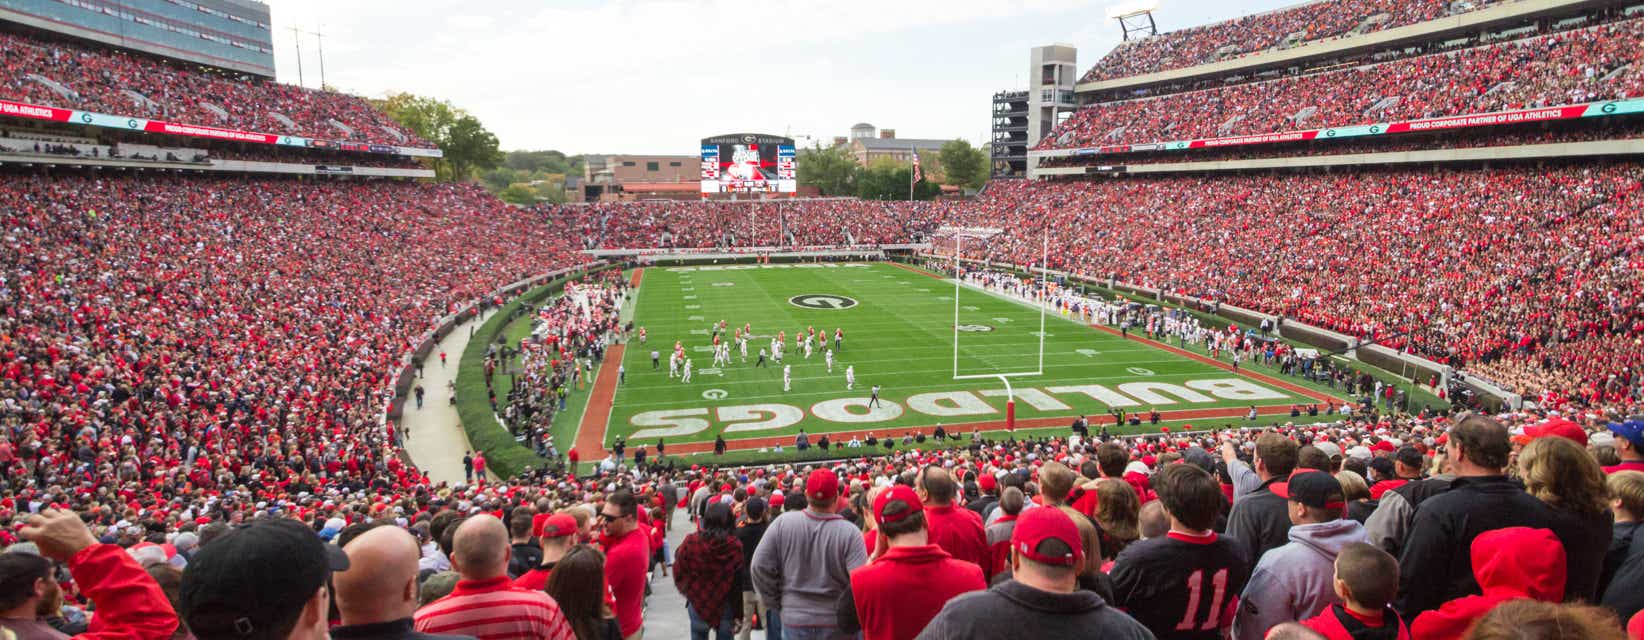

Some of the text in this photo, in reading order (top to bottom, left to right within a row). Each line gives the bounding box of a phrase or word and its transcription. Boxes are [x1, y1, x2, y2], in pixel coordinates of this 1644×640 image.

[3, 103, 18, 113] UGA
[20, 105, 53, 118] ATHLETICS
[1601, 103, 1616, 114] G
[82, 113, 93, 123] G
[1409, 122, 1430, 130] PROUD
[1431, 118, 1467, 128] CORPORATE
[1467, 116, 1497, 126] PARTNER
[1508, 113, 1524, 121] UGA
[1524, 109, 1562, 120] ATHLETICS
[1326, 129, 1336, 137] G
[1369, 125, 1379, 134] G
[1280, 133, 1303, 141] ATHLETICS
[629, 378, 1291, 439] BULLDOGS
[1175, 568, 1228, 630] 11
